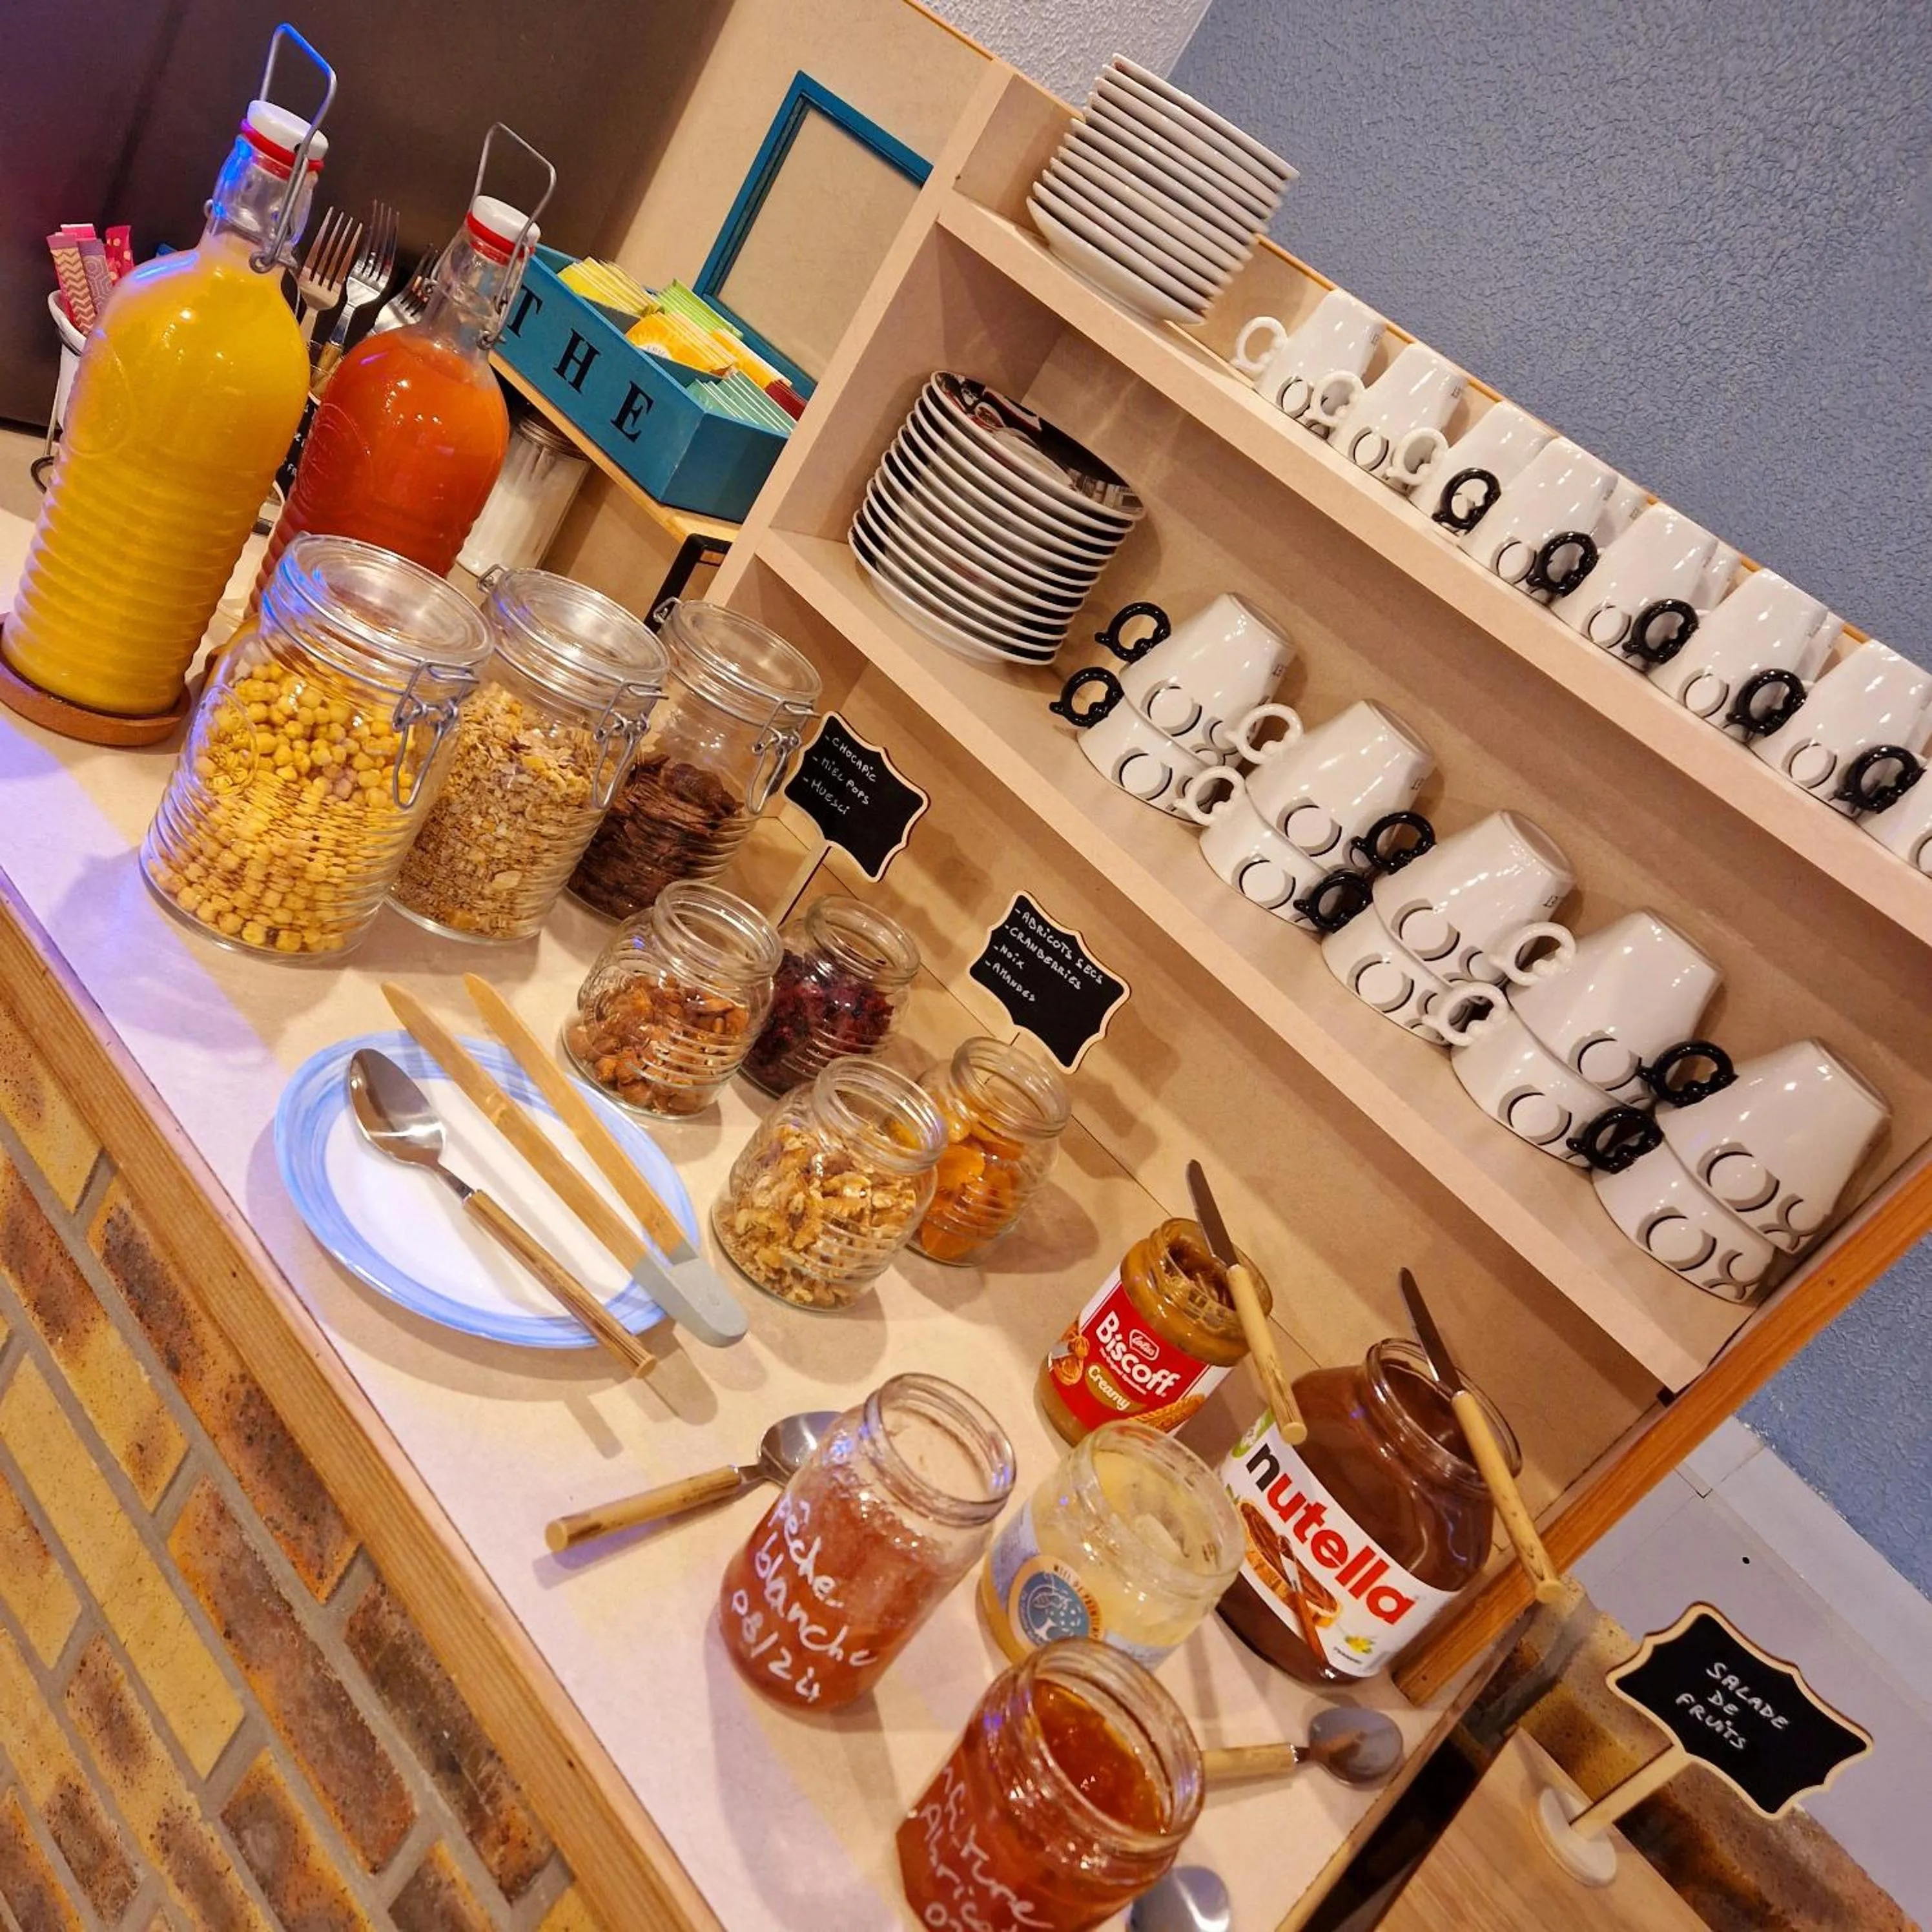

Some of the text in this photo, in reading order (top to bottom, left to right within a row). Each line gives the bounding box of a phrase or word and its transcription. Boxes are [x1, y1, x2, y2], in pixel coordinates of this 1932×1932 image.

[1088, 1364, 1130, 1411] Creamy
[1096, 1310, 1181, 1395] Biscoff
[1246, 1443, 1415, 1625] nutella
[755, 1532, 878, 1666] blanche
[732, 1590, 821, 1702] 08/24
[1705, 1662, 1790, 1730] SALADE
[1707, 1690, 1740, 1716] DE
